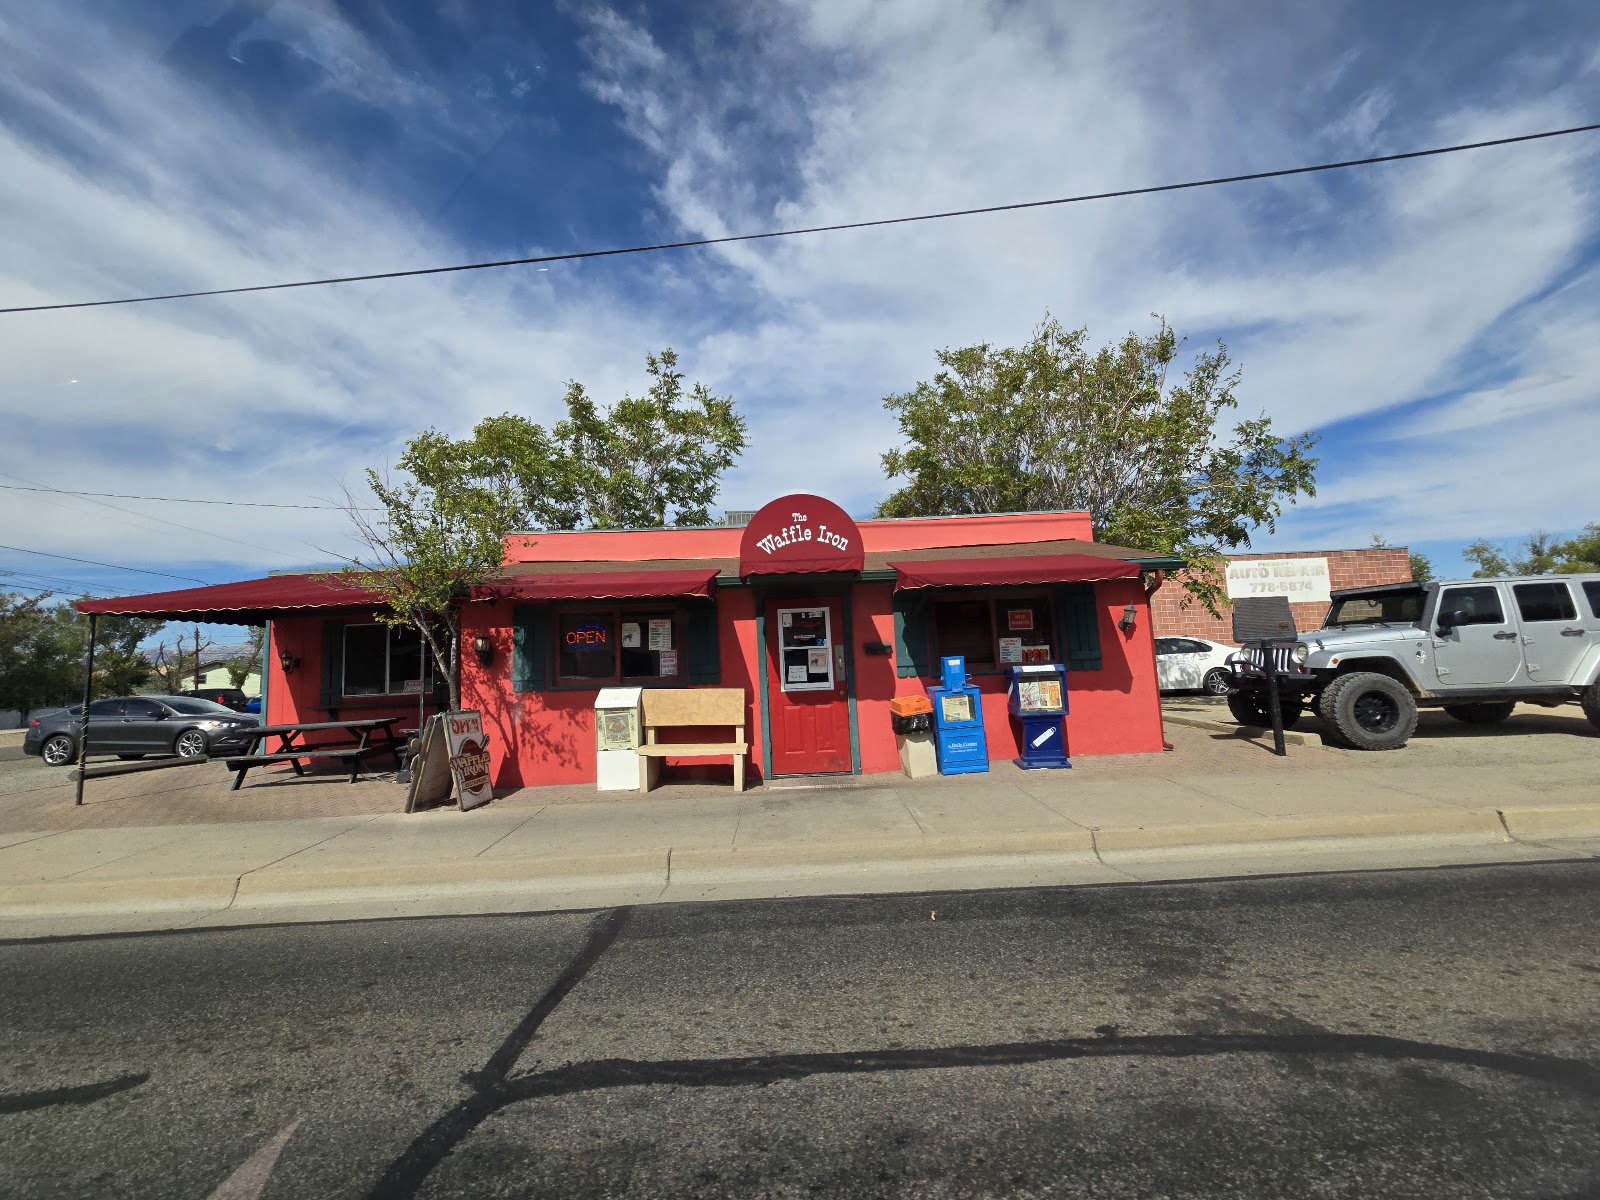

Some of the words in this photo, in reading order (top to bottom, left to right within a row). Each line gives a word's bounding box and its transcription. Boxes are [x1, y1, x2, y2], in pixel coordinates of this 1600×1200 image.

[792, 512, 807, 522] The
[756, 525, 812, 555] Waffle
[817, 525, 849, 551] Iron
[1229, 567, 1270, 579] AUTO
[1273, 565, 1326, 578] REPAIR
[566, 630, 606, 644] OPEN
[451, 752, 490, 771] WAFFLE
[463, 764, 485, 777] IRON
